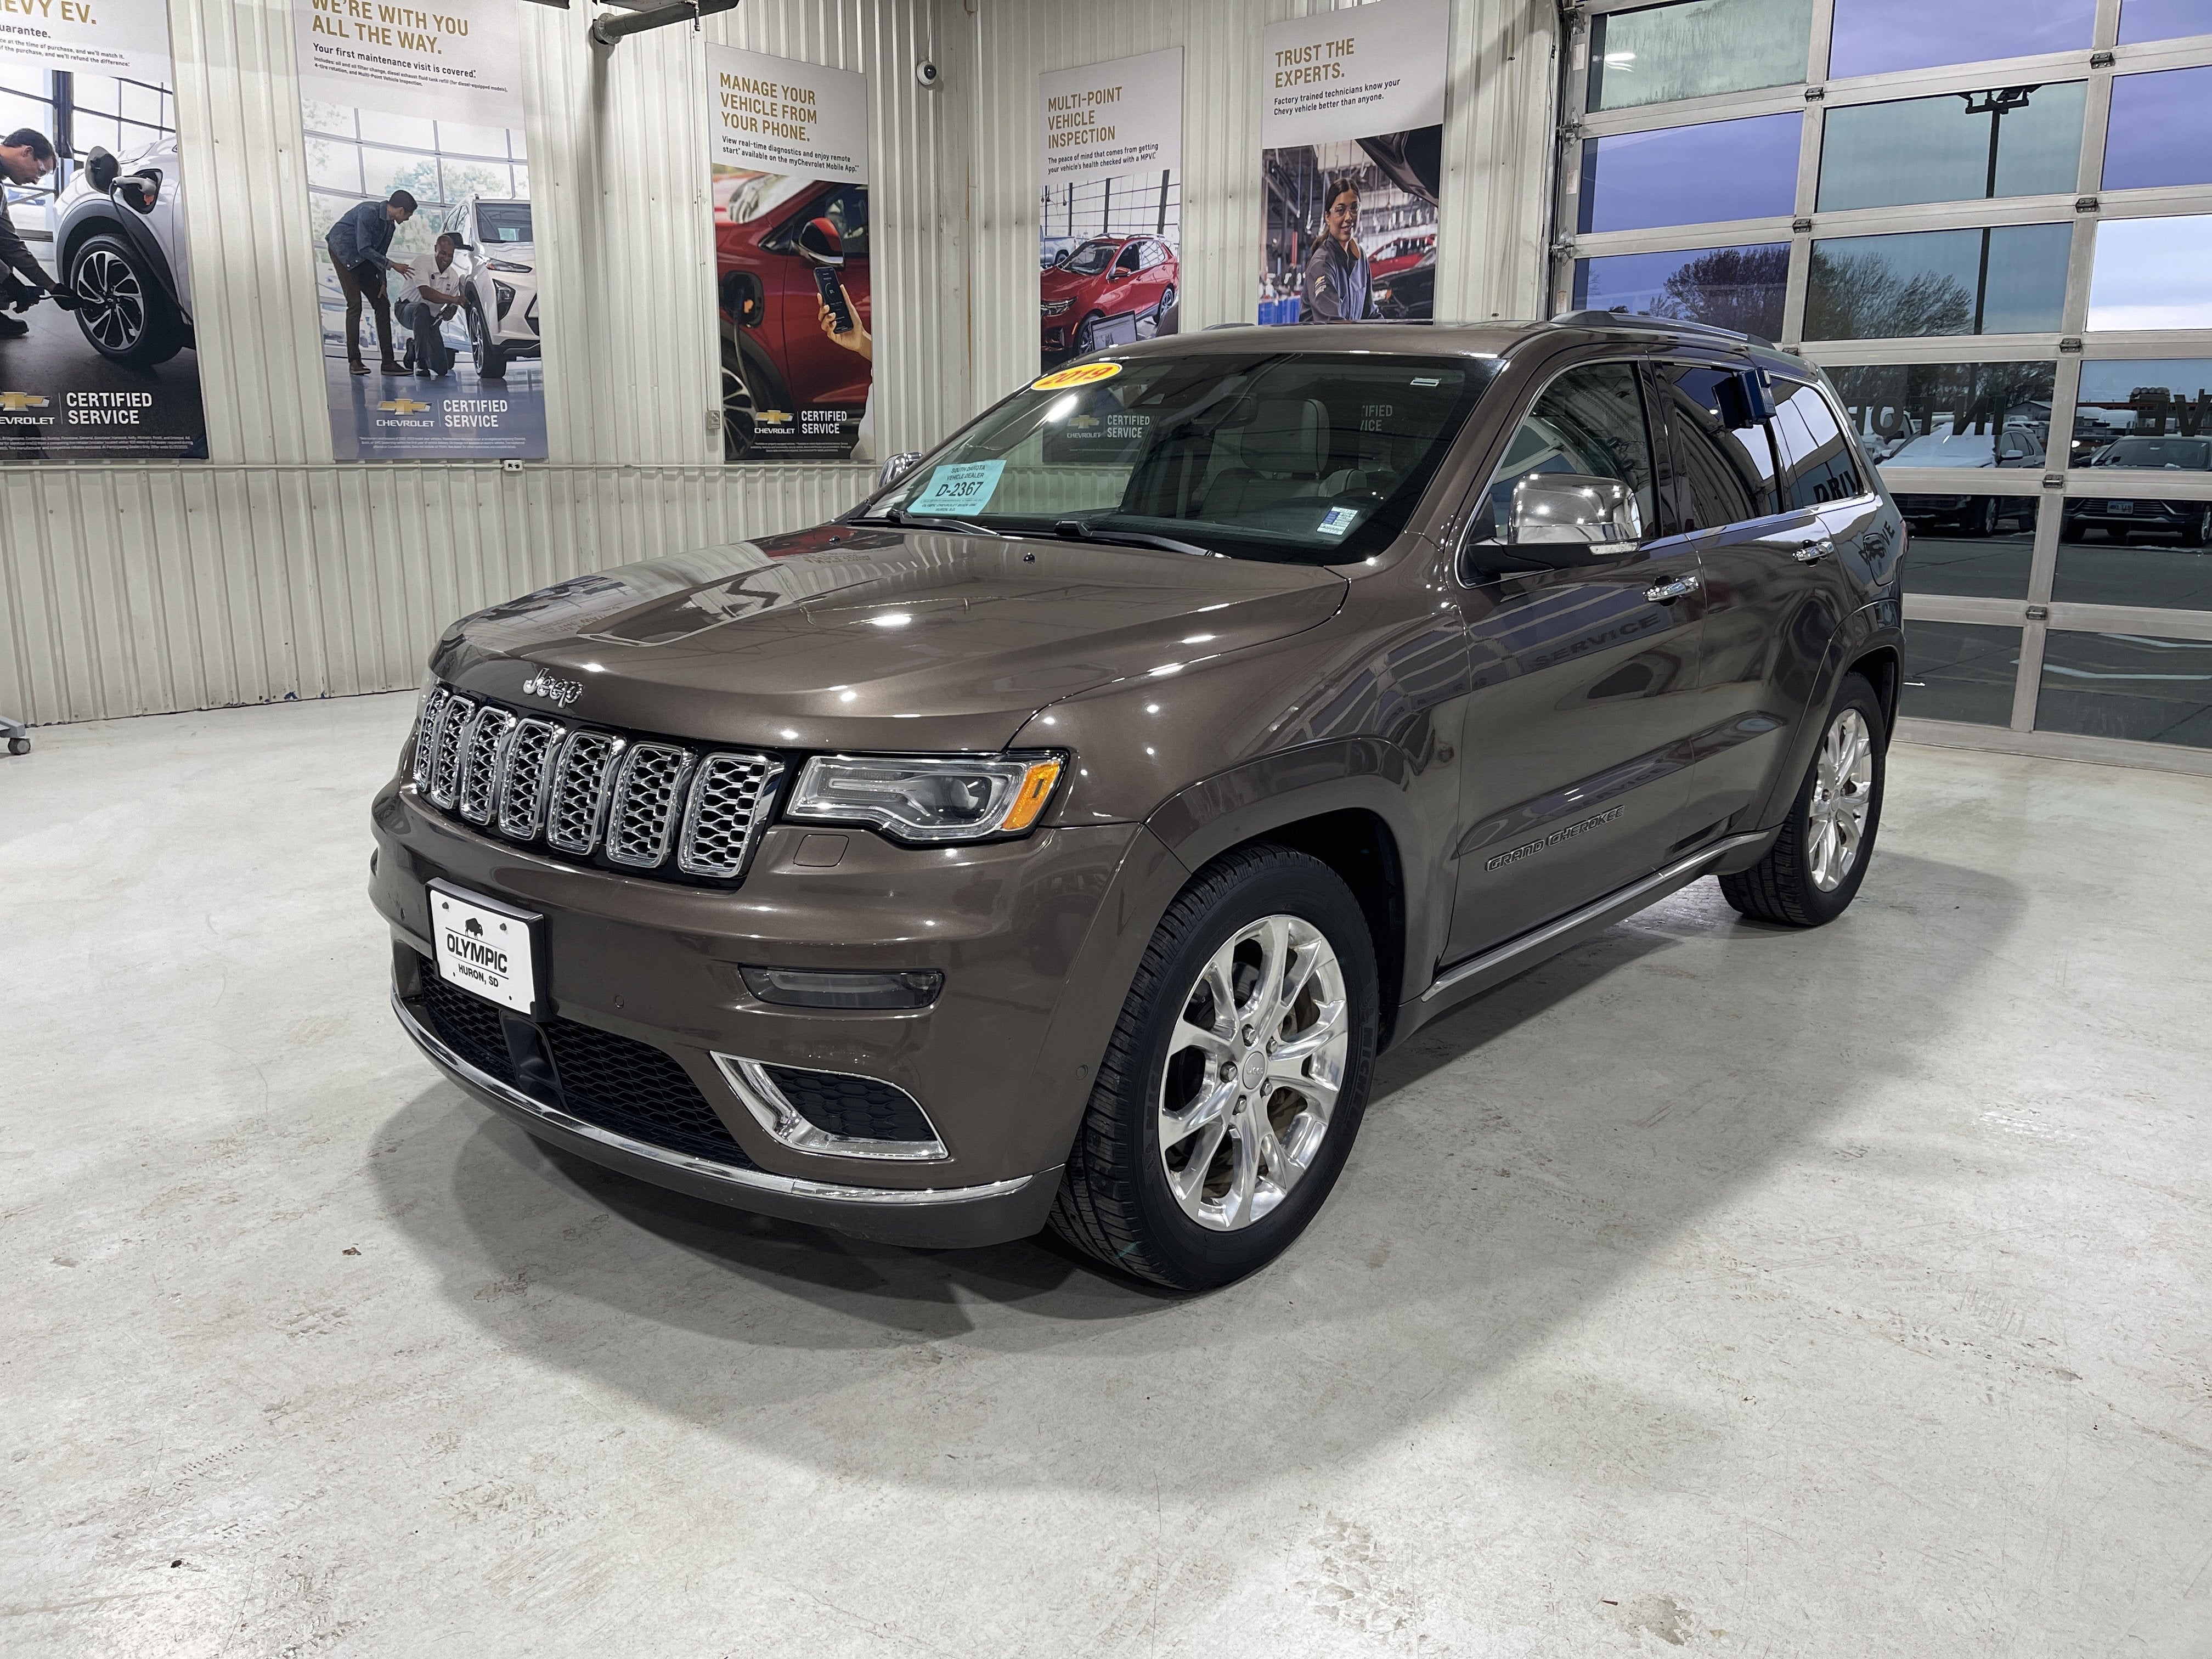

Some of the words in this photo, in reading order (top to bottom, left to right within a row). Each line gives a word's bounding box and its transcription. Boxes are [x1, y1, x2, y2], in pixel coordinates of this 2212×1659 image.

[0, 0, 51, 18] EVY
[61, 1, 97, 25] EV.
[312, 0, 372, 20] WE'RE
[379, 3, 427, 30] WITH
[432, 14, 469, 36] YOU
[312, 14, 349, 38] ALL
[354, 22, 392, 46] THE
[397, 30, 442, 54] WAY.
[16, 48, 43, 57] purchase,
[47, 45, 75, 53] purchase,
[313, 43, 334, 54] Your
[336, 47, 355, 58] first
[358, 53, 411, 68] maintenance
[413, 62, 431, 71] visit
[433, 64, 440, 72] is
[1275, 44, 1322, 67] TRUST
[1325, 37, 1355, 59] THE
[1275, 62, 1345, 88] EXPERTS.
[720, 72, 777, 99] MANAGE
[781, 84, 815, 105] YOUR
[1048, 86, 1122, 112] MULTI-POINT
[1274, 94, 1299, 106] Factory
[1300, 91, 1323, 103] trained
[1325, 85, 1363, 99] technicians
[1364, 82, 1383, 92] know
[1384, 78, 1401, 89] your
[720, 92, 778, 117] VEHICLE
[782, 104, 817, 125] FROM
[1274, 106, 1293, 116] Chevy
[1295, 103, 1317, 114] vehicle
[1318, 99, 1339, 110] better
[1341, 98, 1356, 106] than
[1358, 93, 1384, 104] anyone.
[721, 111, 758, 133] YOUR
[763, 120, 810, 142] PHONE.
[1048, 110, 1095, 131] VEHICLE
[1048, 126, 1115, 149] INSPECTION
[722, 136, 737, 145] View
[738, 139, 766, 151] real-time
[768, 144, 802, 156] diagnostics
[815, 152, 829, 161] enjoy
[831, 155, 850, 163] remote
[742, 149, 768, 160] available
[778, 155, 787, 163] the
[789, 158, 825, 169] myChevrolet
[826, 162, 844, 171] Mobile
[1058, 155, 1073, 165] peace
[1080, 152, 1093, 160] mind
[1138, 143, 1159, 153] getting
[1060, 162, 1081, 171] vehicle's
[1082, 161, 1099, 169] health
[1100, 157, 1121, 166] checked
[1122, 155, 1135, 163] with
[1037, 367, 1113, 386] 2019
[66, 392, 153, 408] CERTIFIED
[443, 399, 508, 413] CERTIFIED
[68, 410, 140, 425] SERVICE
[444, 415, 499, 427] SERVICE
[801, 410, 847, 422] CERTIFIED
[1107, 415, 1150, 426] CERTIFIED
[802, 423, 840, 434] SERVICE
[1107, 427, 1143, 438] SERVICE
[935, 481, 984, 497] D-2367
[523, 667, 585, 709] Jeep
[1485, 839, 1544, 872] GRAND
[1546, 805, 1625, 847] CHEROKEE
[447, 933, 507, 973] OLYMPIC
[458, 963, 487, 985] HURON,
[488, 975, 499, 988] SD
